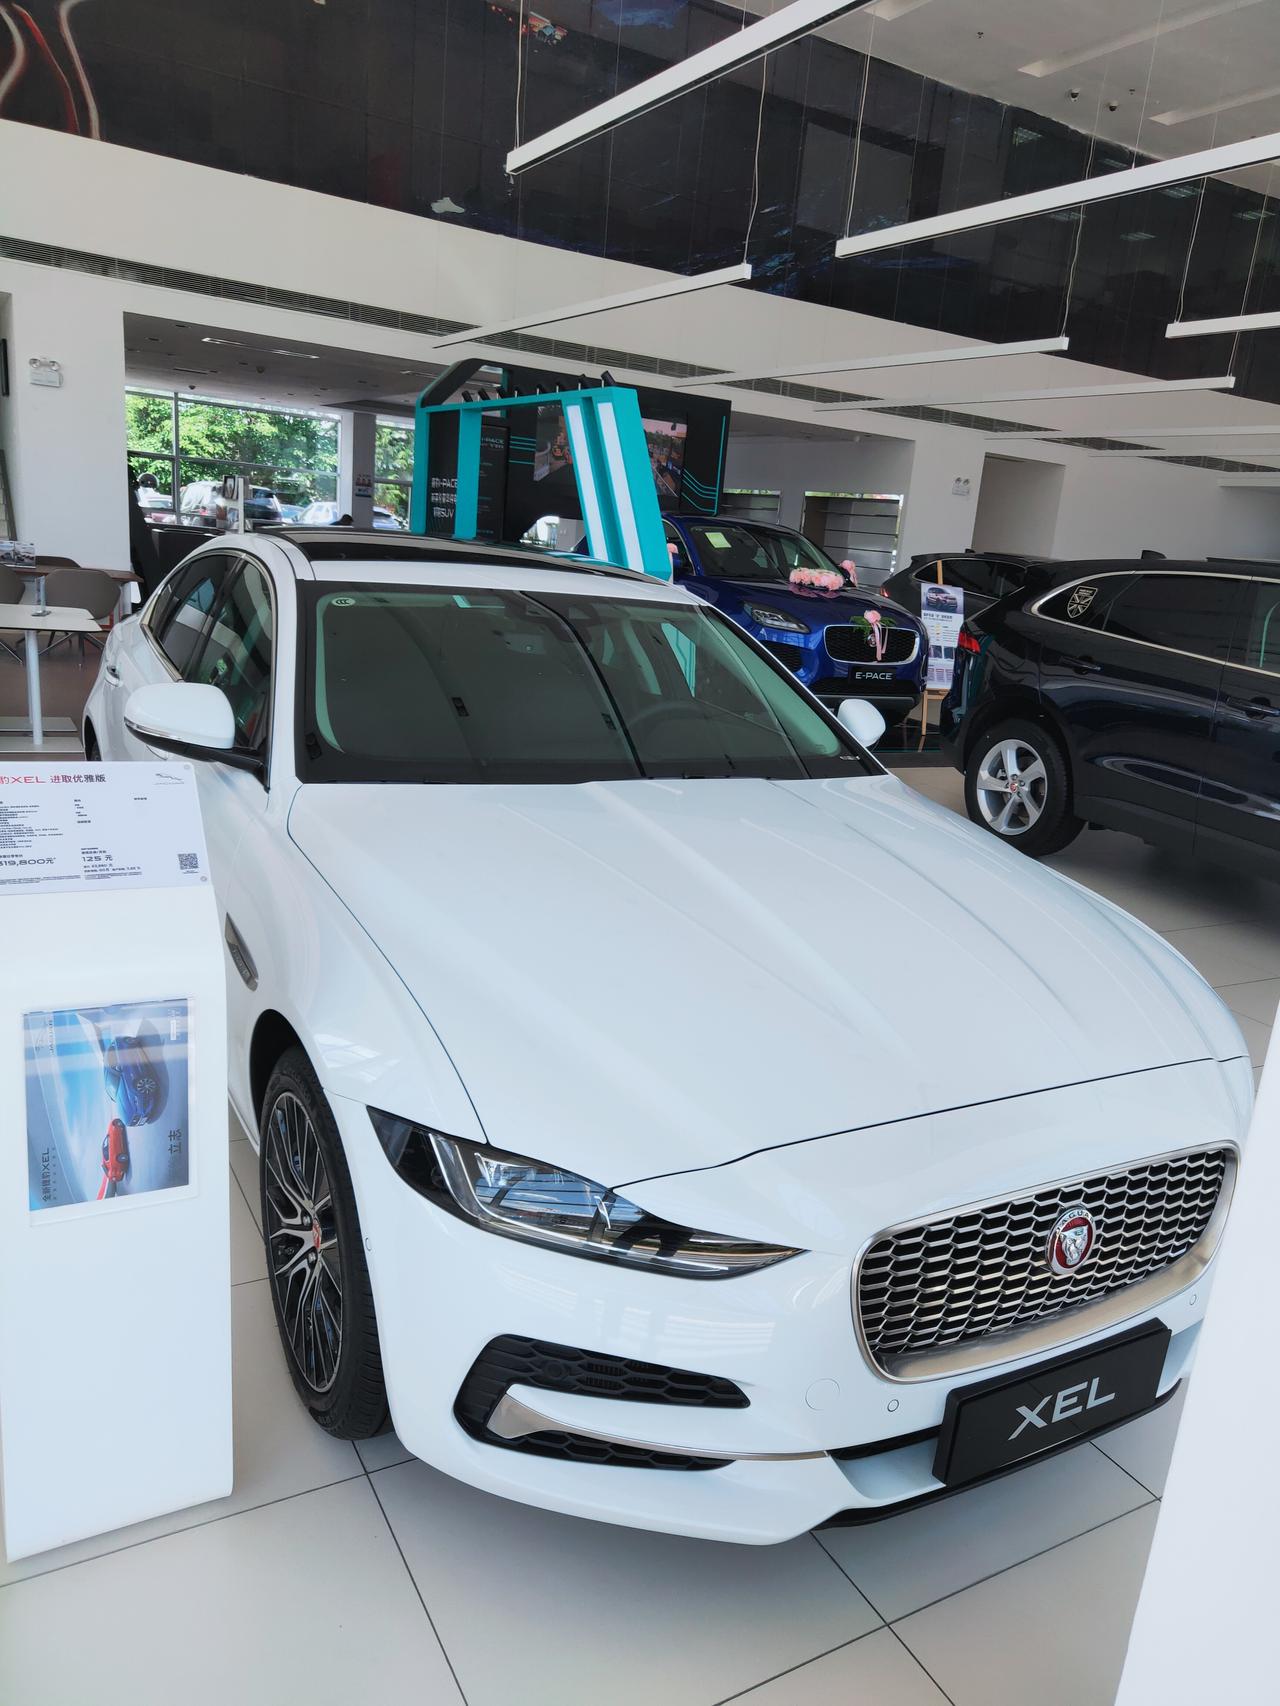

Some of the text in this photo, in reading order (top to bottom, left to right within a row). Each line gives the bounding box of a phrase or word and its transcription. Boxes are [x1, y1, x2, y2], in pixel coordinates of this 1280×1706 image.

[855, 671, 893, 680] E-PACE
[50, 773, 107, 784] 进取优雅版
[105, 854, 113, 862] 元
[1056, 1209, 1094, 1233] JAGUAR
[1007, 1376, 1116, 1441] XEL
